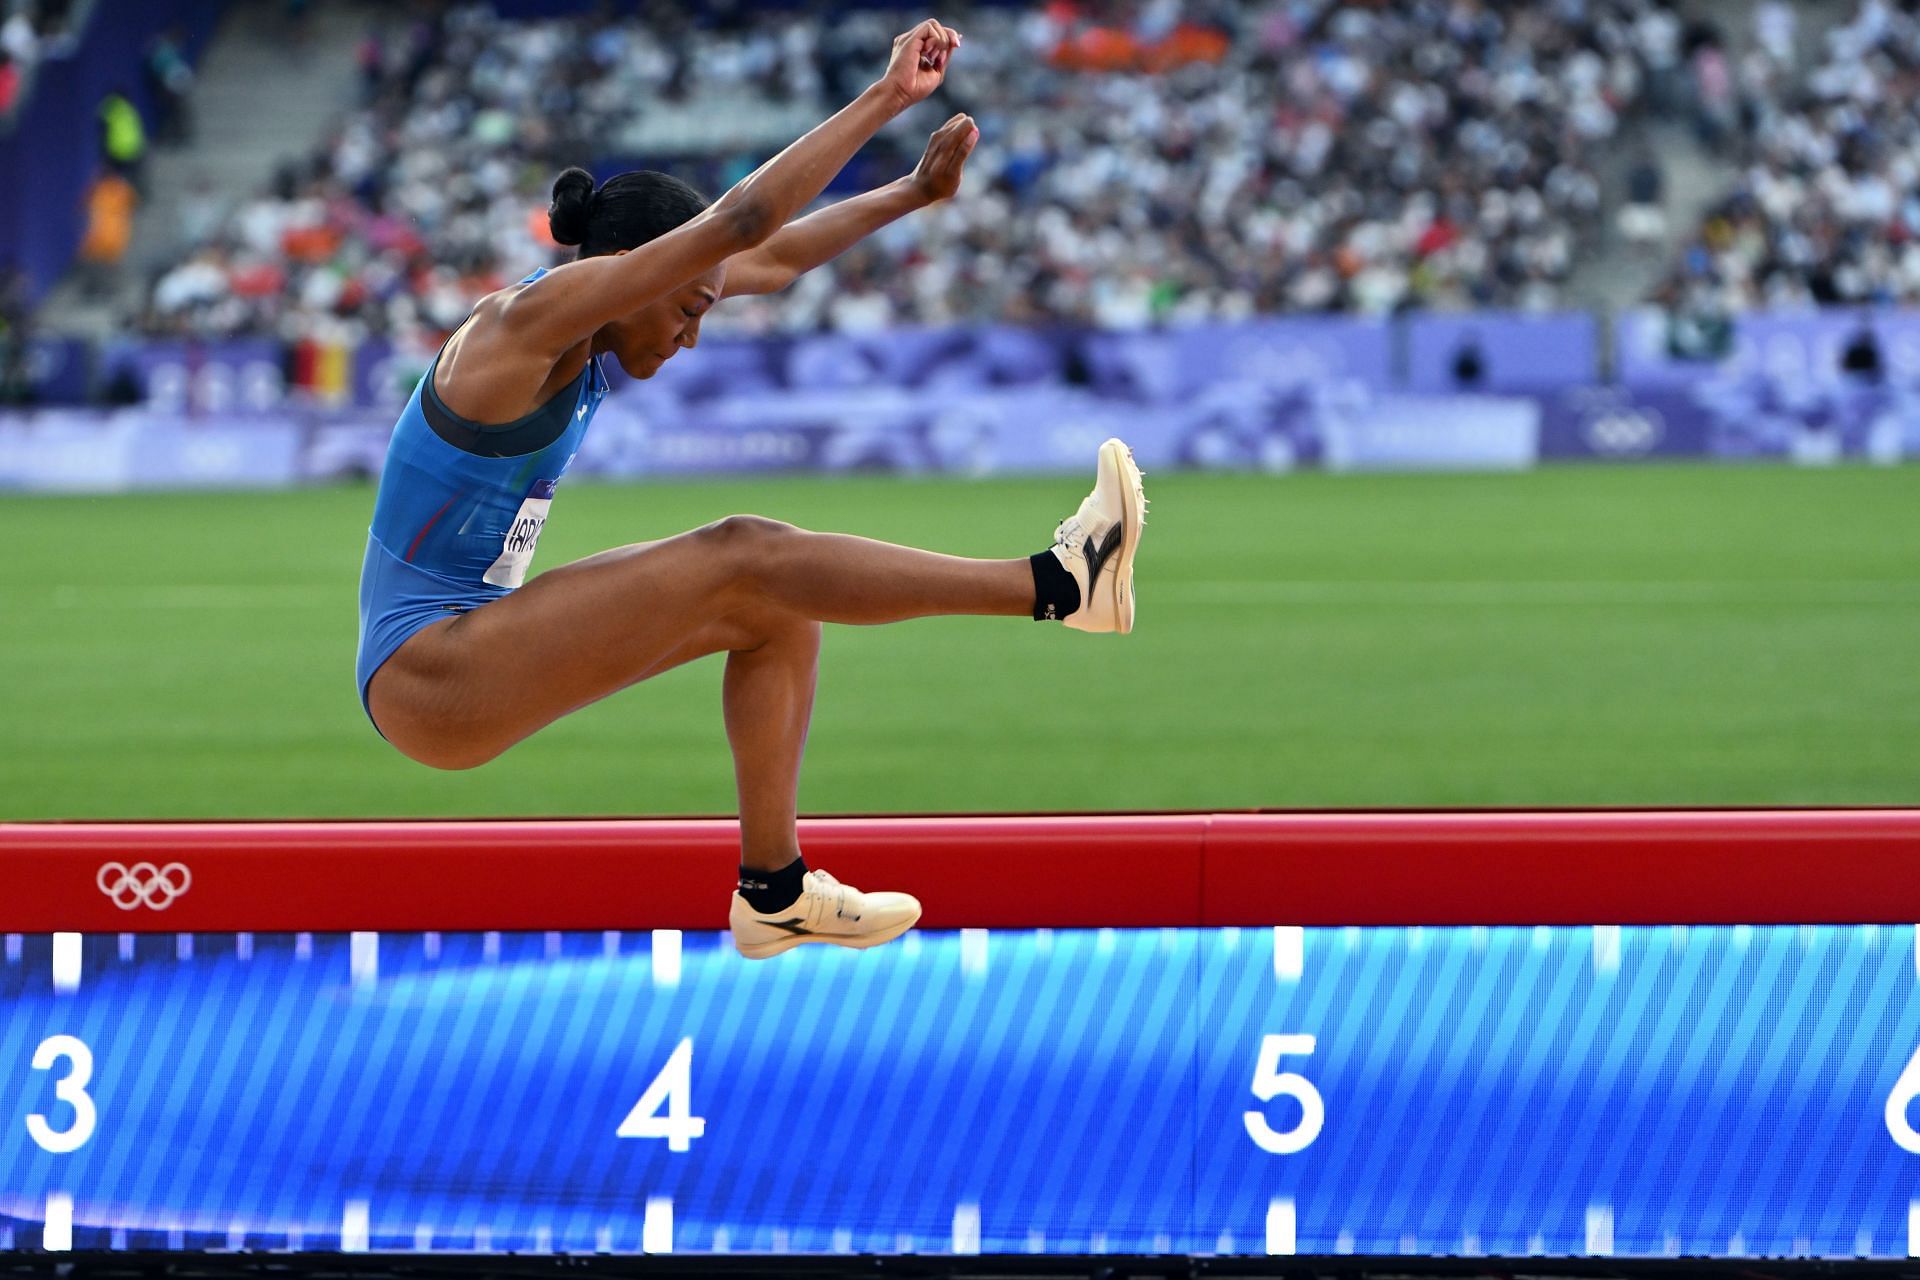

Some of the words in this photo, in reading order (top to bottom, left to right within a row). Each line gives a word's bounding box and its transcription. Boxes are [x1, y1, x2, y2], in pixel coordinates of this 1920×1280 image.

[25, 1034, 97, 1153] 3
[616, 1036, 707, 1152] 4
[1243, 1033, 1325, 1154] 5
